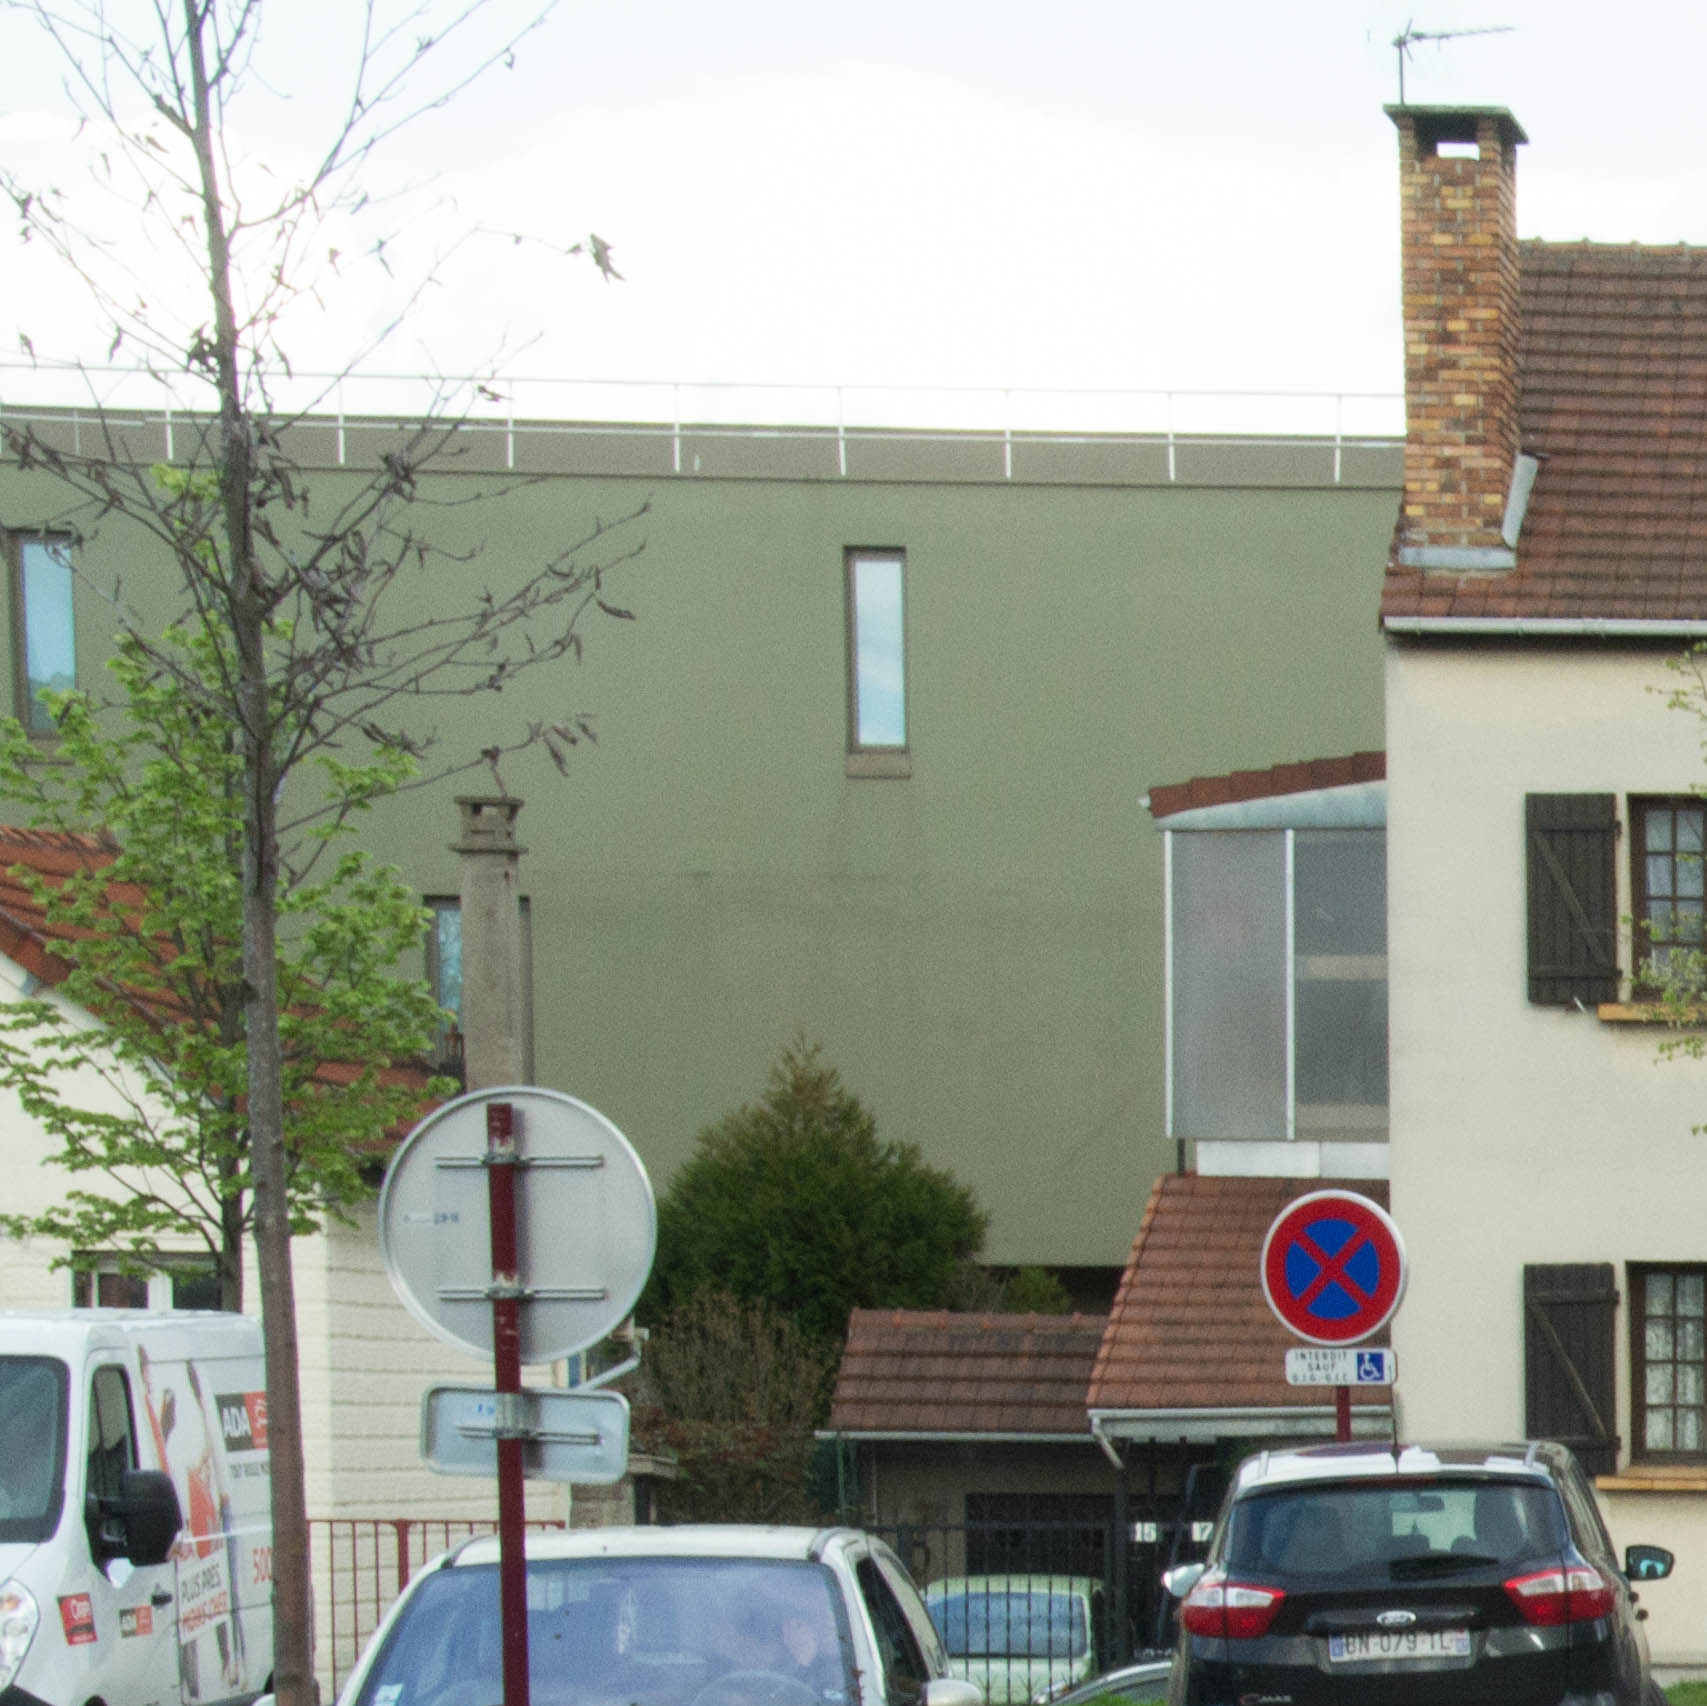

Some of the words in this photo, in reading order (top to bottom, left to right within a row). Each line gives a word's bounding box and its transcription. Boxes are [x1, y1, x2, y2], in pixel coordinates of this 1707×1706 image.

[1295, 1351, 1348, 1361] INTERDIT
[1307, 1362, 1336, 1372] SAUF
[223, 1406, 252, 1438] ADA
[1135, 1521, 1157, 1542] 15
[1191, 1521, 1214, 1542] 17
